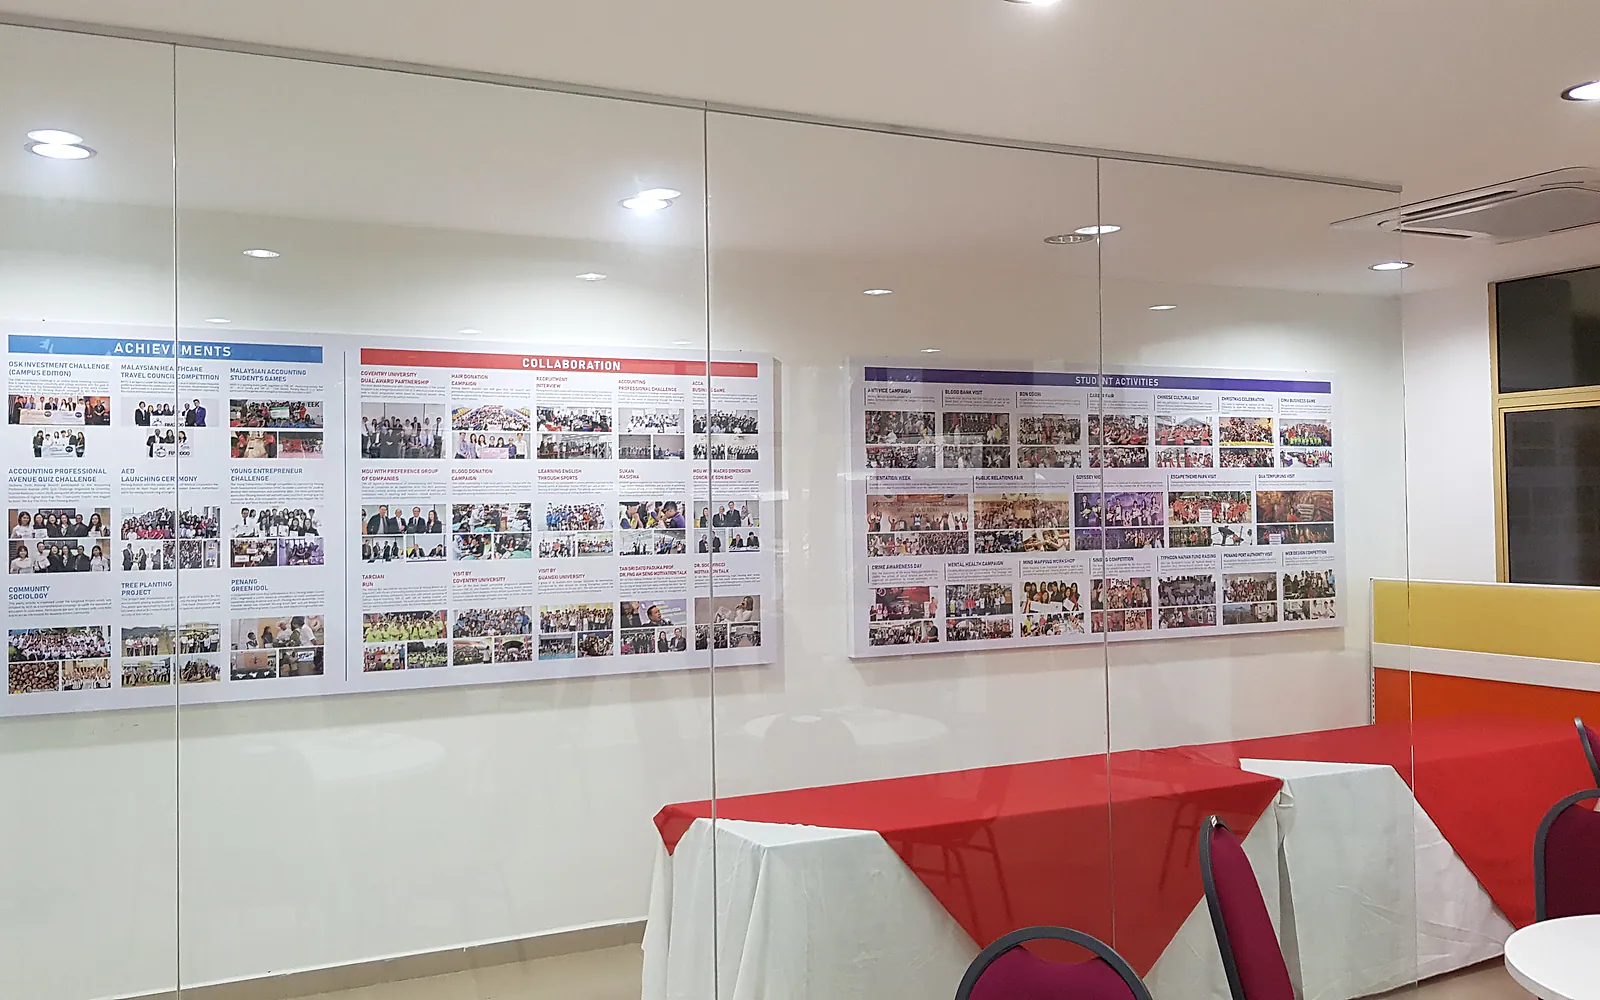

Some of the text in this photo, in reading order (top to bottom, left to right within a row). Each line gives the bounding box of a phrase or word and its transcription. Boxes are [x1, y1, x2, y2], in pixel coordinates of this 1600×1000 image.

[114, 342, 231, 357] ACHIEVMENTS
[24, 361, 67, 370] INVESTMENT
[68, 362, 110, 371] CHALLENGE
[121, 364, 203, 373] MALAYSIAN HEATHCARE
[522, 358, 621, 371] COLLABORATION
[8, 369, 41, 378] (CAMPUS
[121, 372, 147, 380] TRAVEL
[229, 367, 307, 377] MALAYSIAN ACCOUNTING
[388, 371, 418, 379] UNIVERSITY
[264, 376, 287, 384] GAMES
[360, 377, 430, 387] DUAL AWARD PARTNERSHIP
[463, 374, 489, 382] DONATION
[1075, 376, 1159, 388] STUDNT ACTIVITIES
[451, 380, 477, 388] CAMPAIGN
[692, 387, 714, 395] BUSINS
[8, 467, 107, 476] ACCOUNTING PROFESSIONAL
[230, 467, 304, 475] YOUNG ENTREPRENEUR
[420, 468, 439, 476] GROUP
[451, 468, 493, 476] BLOOD DONATION
[538, 468, 561, 476] LEARNING
[8, 475, 97, 484] AVENUE QUIZ CHALLENGE
[121, 475, 199, 483] LAUNCHING CERMONY
[361, 475, 399, 483] OF COMPANIES
[451, 475, 477, 483] CAMPAIGN
[121, 580, 173, 590] TREE PLANTING
[230, 578, 258, 586] PENANG
[8, 584, 51, 593] COMMUNITY
[230, 585, 253, 593] GREEN
[8, 592, 48, 601] SOCIOLOGY
[121, 589, 152, 597] PROJECT
